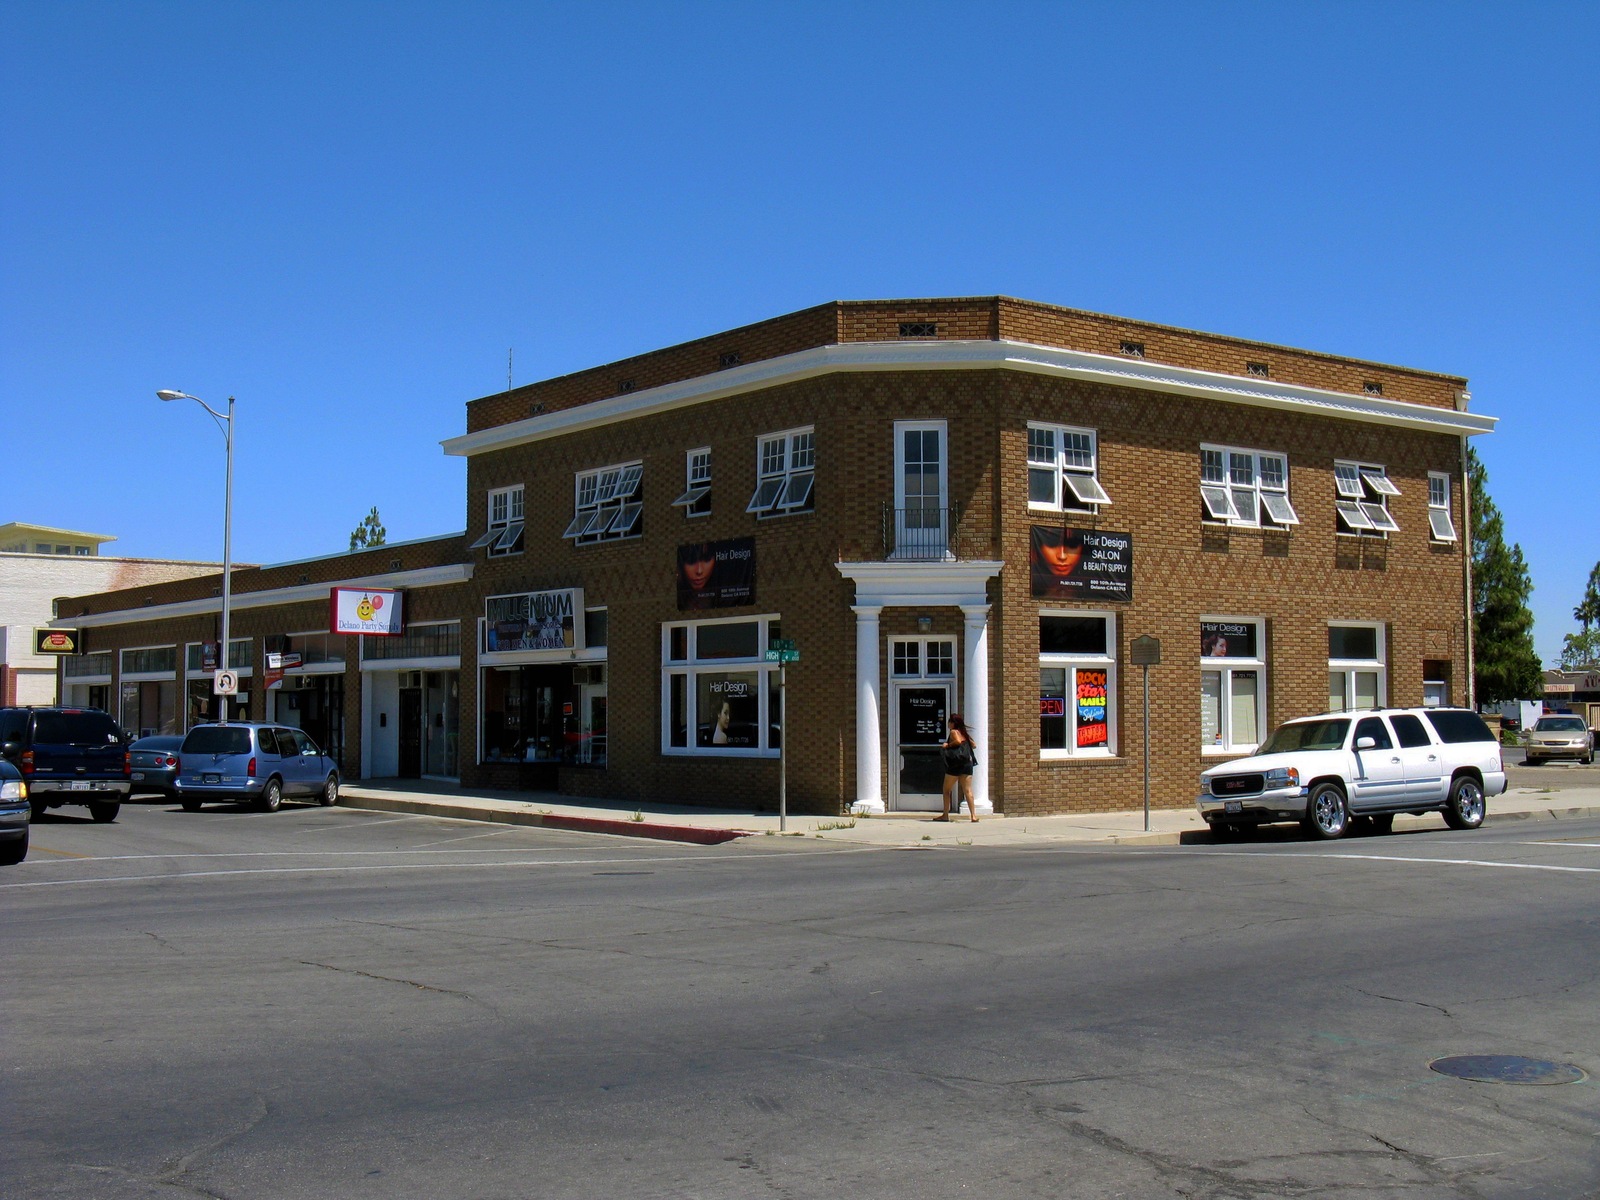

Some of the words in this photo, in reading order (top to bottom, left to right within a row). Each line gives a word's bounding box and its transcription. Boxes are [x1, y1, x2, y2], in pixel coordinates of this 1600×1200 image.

[1083, 534, 1100, 546] Hair
[1101, 536, 1128, 550] Design
[715, 551, 729, 561] Hair
[729, 549, 751, 560] Design
[1091, 549, 1120, 560] SALON
[1083, 561, 1088, 570] &
[1088, 562, 1107, 572] BEAUTY
[1108, 563, 1127, 573] SUPPLY
[488, 592, 573, 621] MILLENIUM
[338, 619, 361, 629] Delano
[361, 621, 377, 633] Party
[1201, 623, 1218, 631] Hair
[1219, 623, 1247, 633] Design
[766, 651, 779, 660] HIGH
[1076, 671, 1106, 685] ROCK
[1584, 678, 1600, 688] AU
[709, 681, 723, 693] Hair
[723, 681, 748, 694] Design
[1076, 684, 1106, 699] Star
[1040, 700, 1063, 714] PEN
[1080, 697, 1106, 706] NAILS
